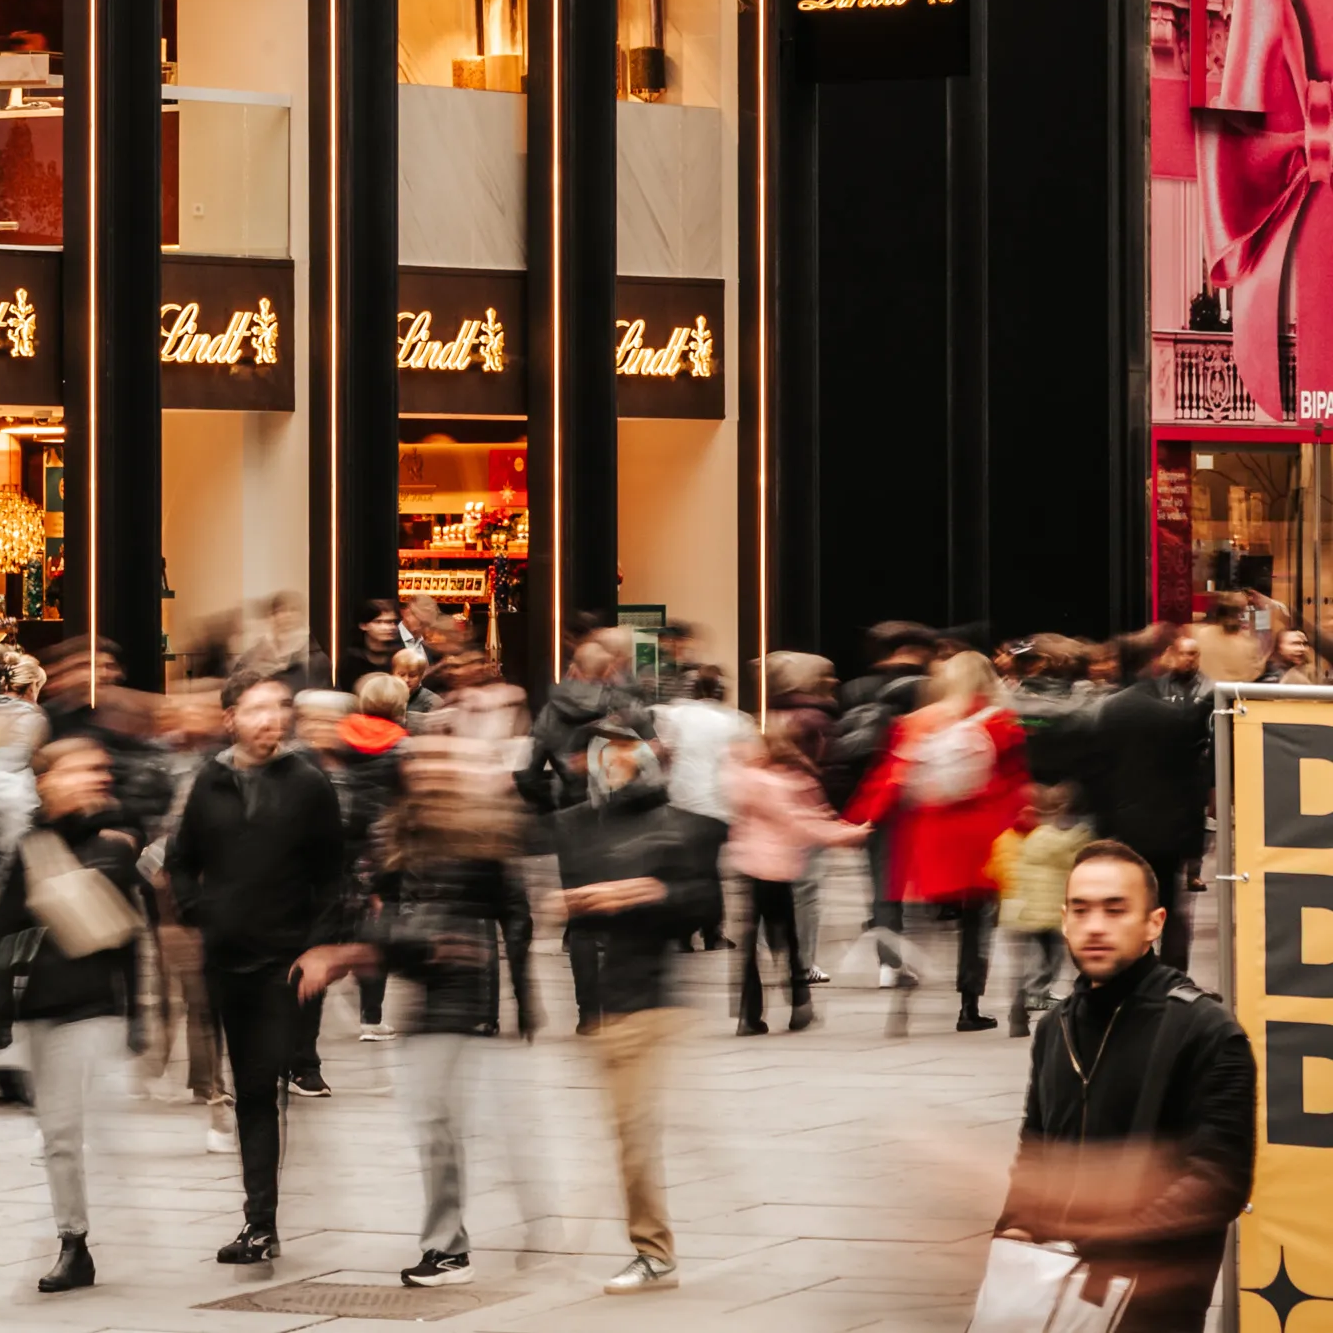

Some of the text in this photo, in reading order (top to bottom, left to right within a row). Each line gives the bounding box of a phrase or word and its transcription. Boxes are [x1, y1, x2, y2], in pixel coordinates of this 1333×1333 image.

[160, 302, 252, 364] Lindt
[397, 309, 483, 372] Lindt
[615, 318, 692, 377] Lindt
[1300, 390, 1333, 420] BIPA
